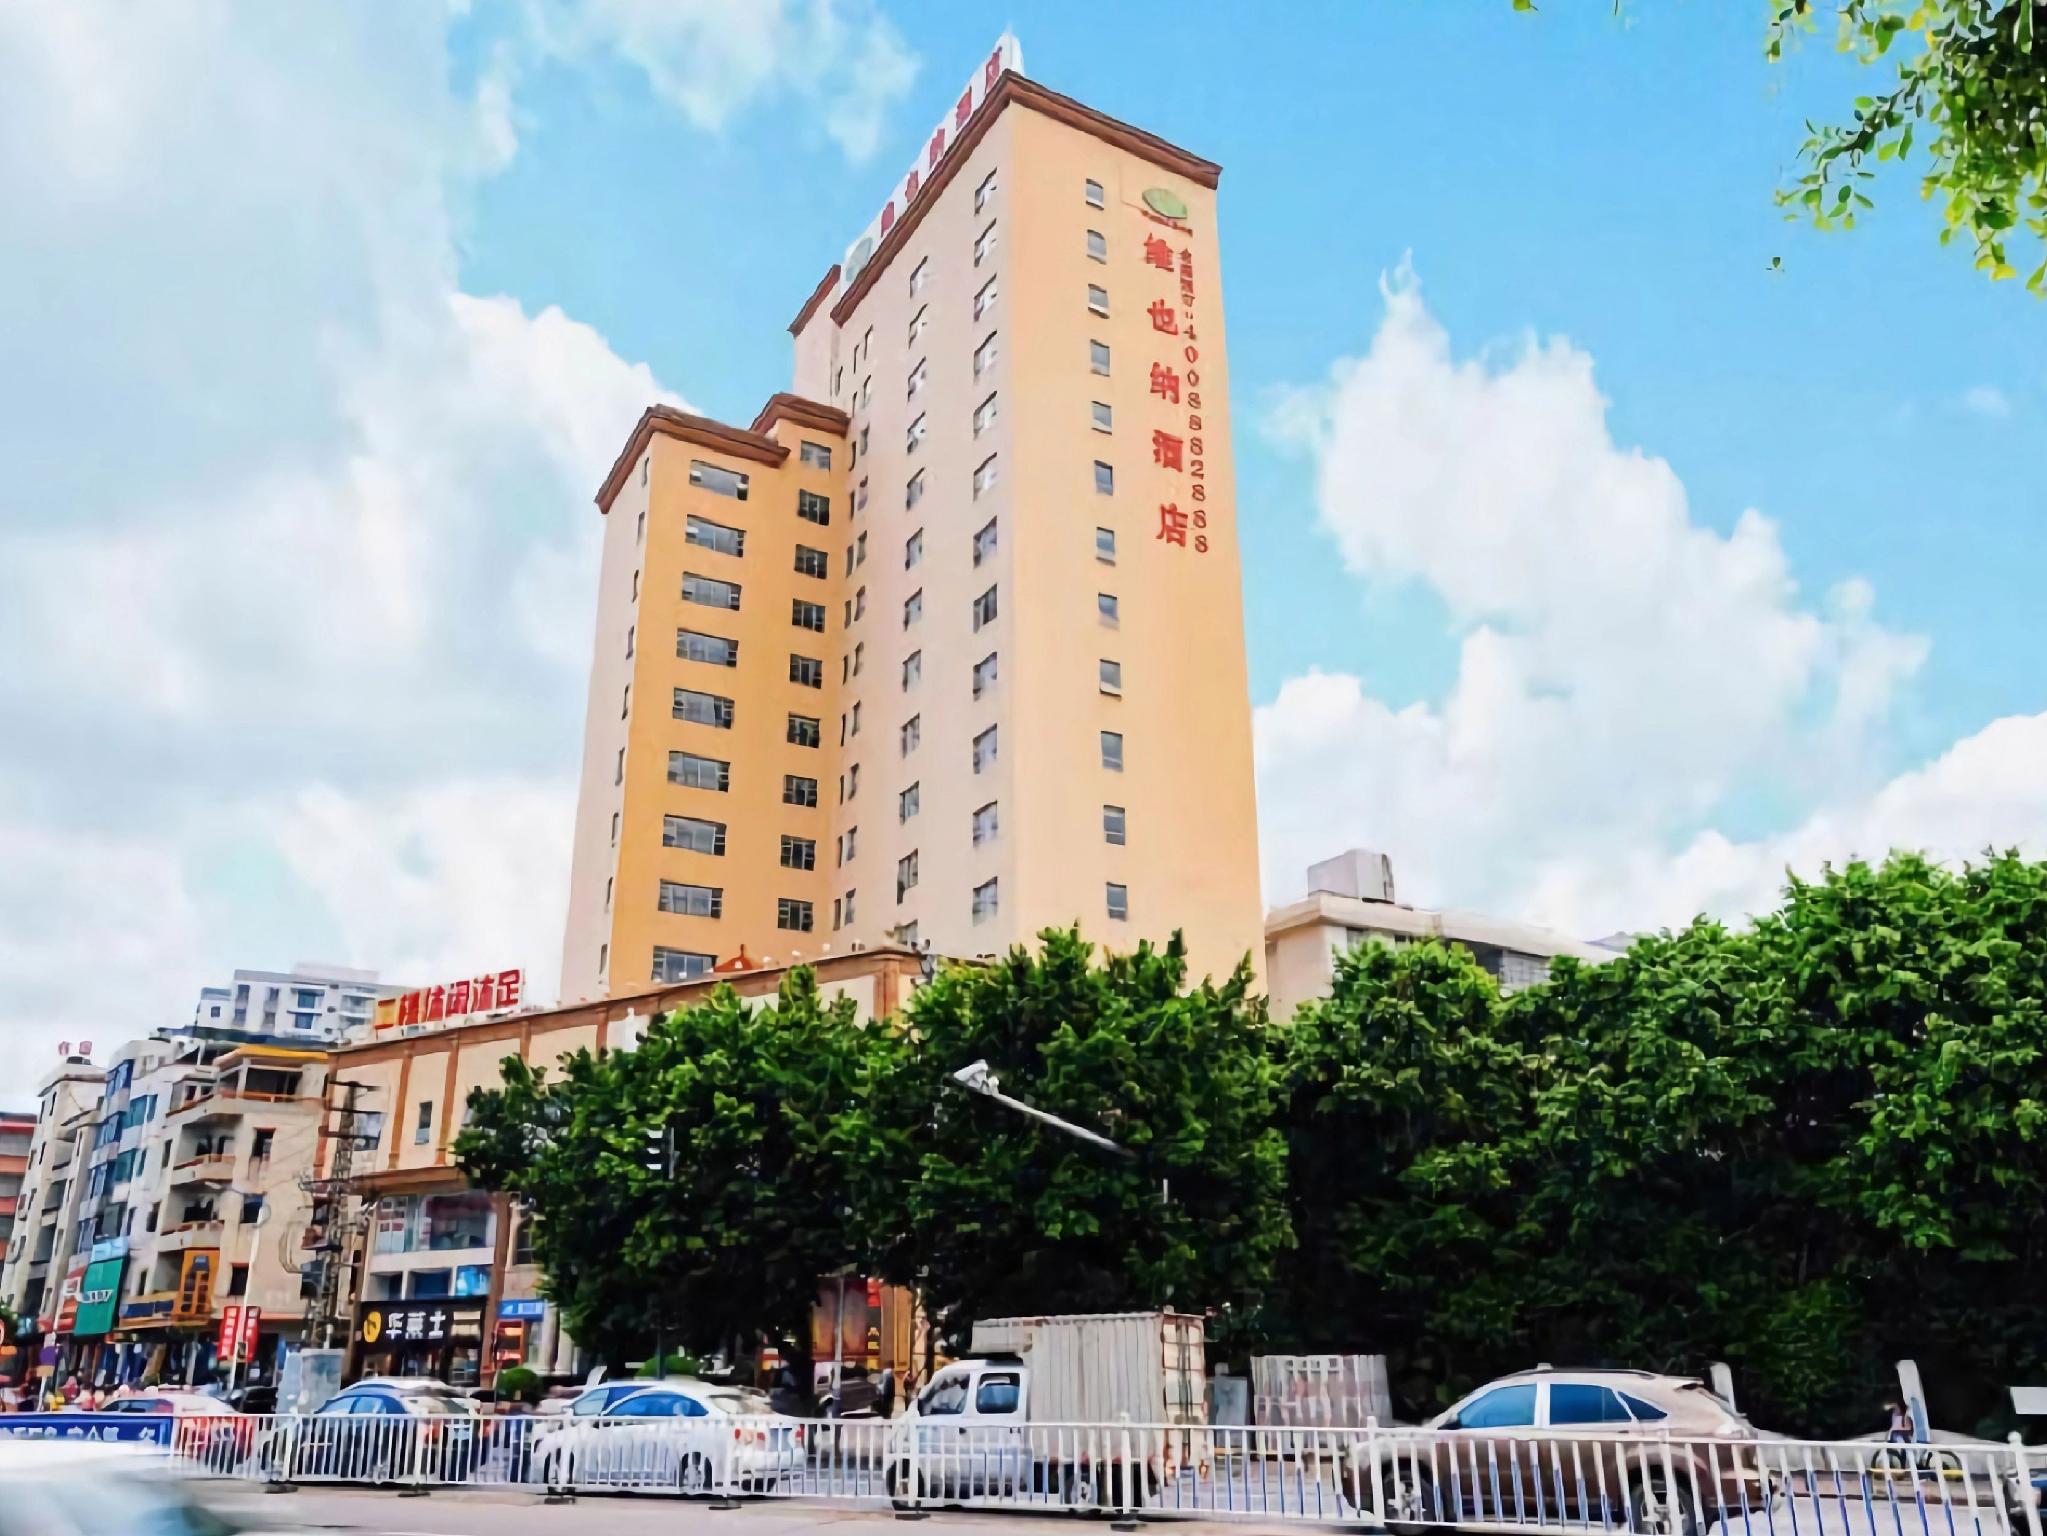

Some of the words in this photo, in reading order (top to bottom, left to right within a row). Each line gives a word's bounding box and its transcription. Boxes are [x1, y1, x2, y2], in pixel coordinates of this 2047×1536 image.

[1144, 232, 1189, 547] 维也纳酒店
